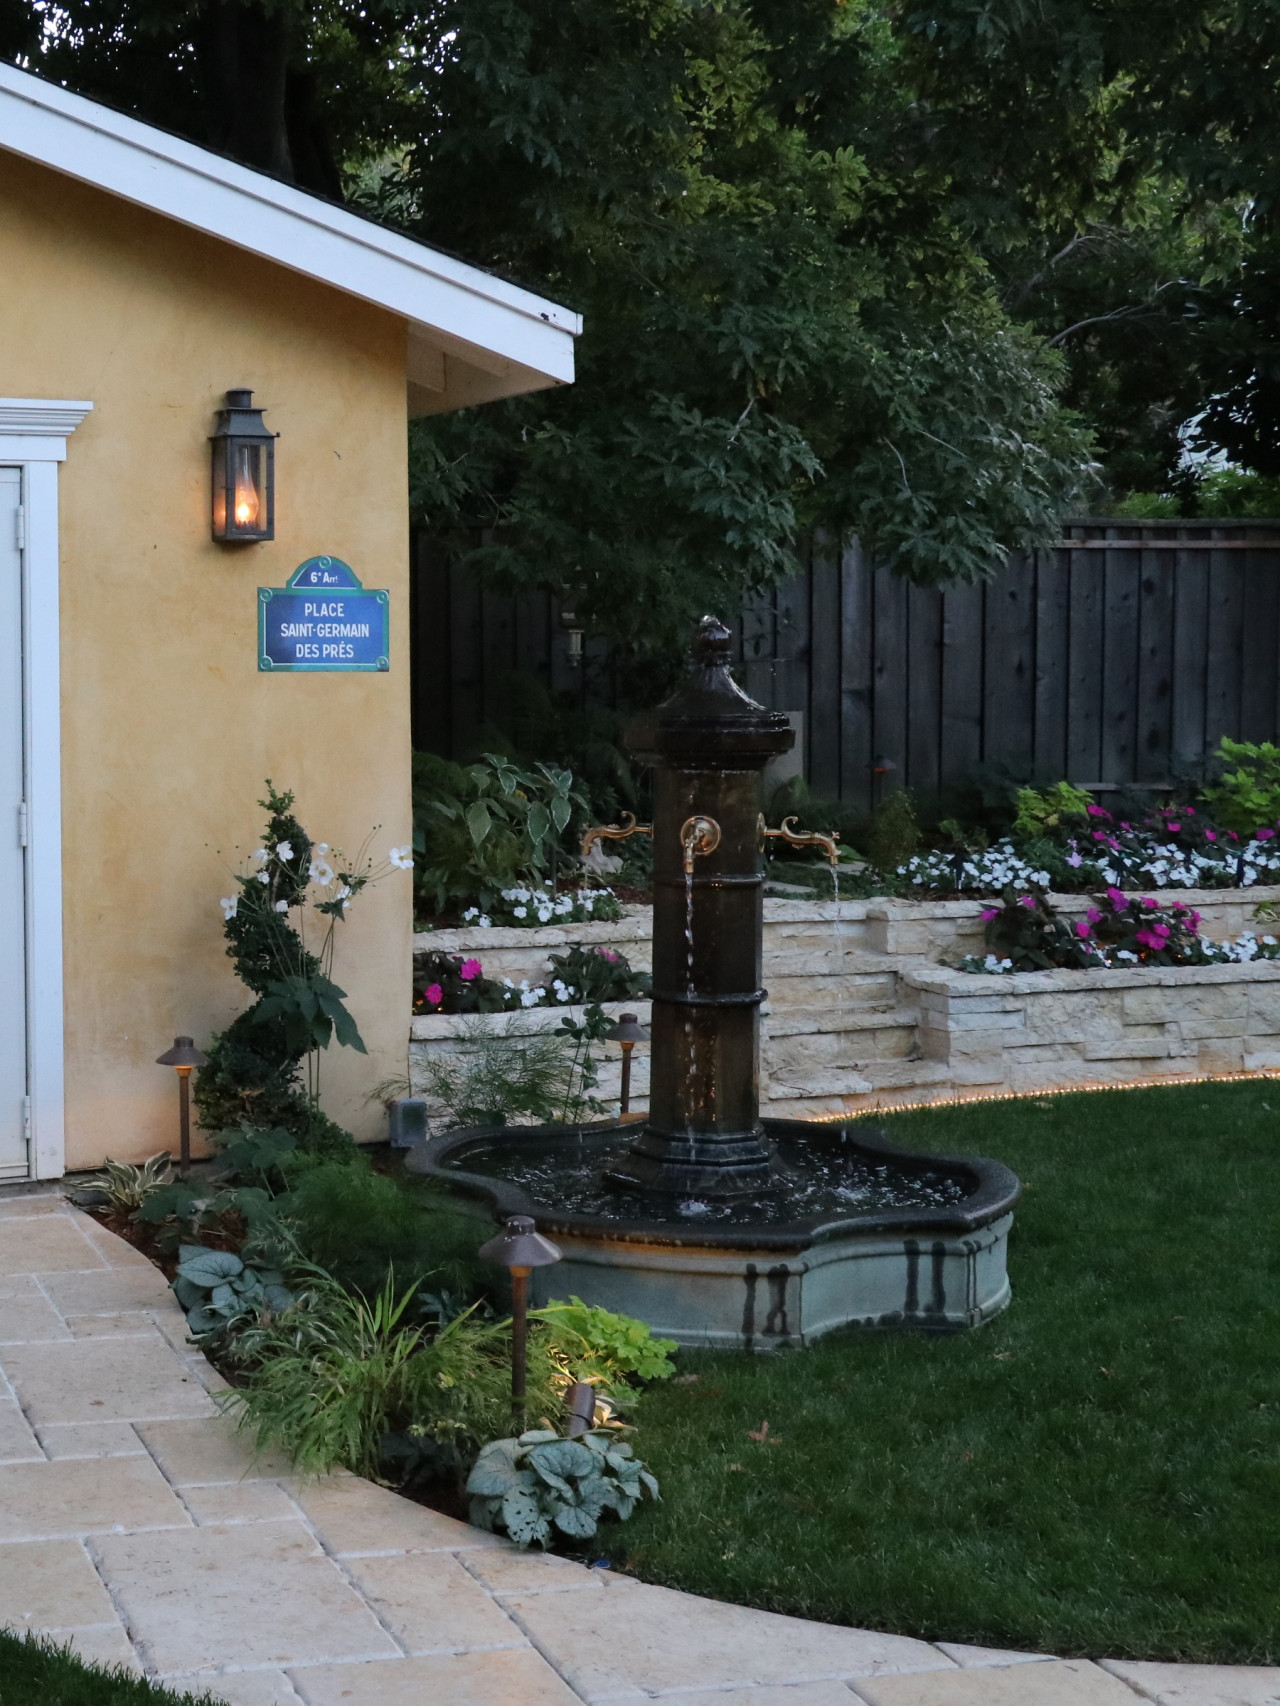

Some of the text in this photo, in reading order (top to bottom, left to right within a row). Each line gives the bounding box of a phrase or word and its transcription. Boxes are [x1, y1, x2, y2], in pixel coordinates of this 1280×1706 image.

[304, 602, 345, 617] PLACE
[280, 623, 370, 638] SAINT-GERMAIN
[295, 641, 354, 659] DES PRÉS
